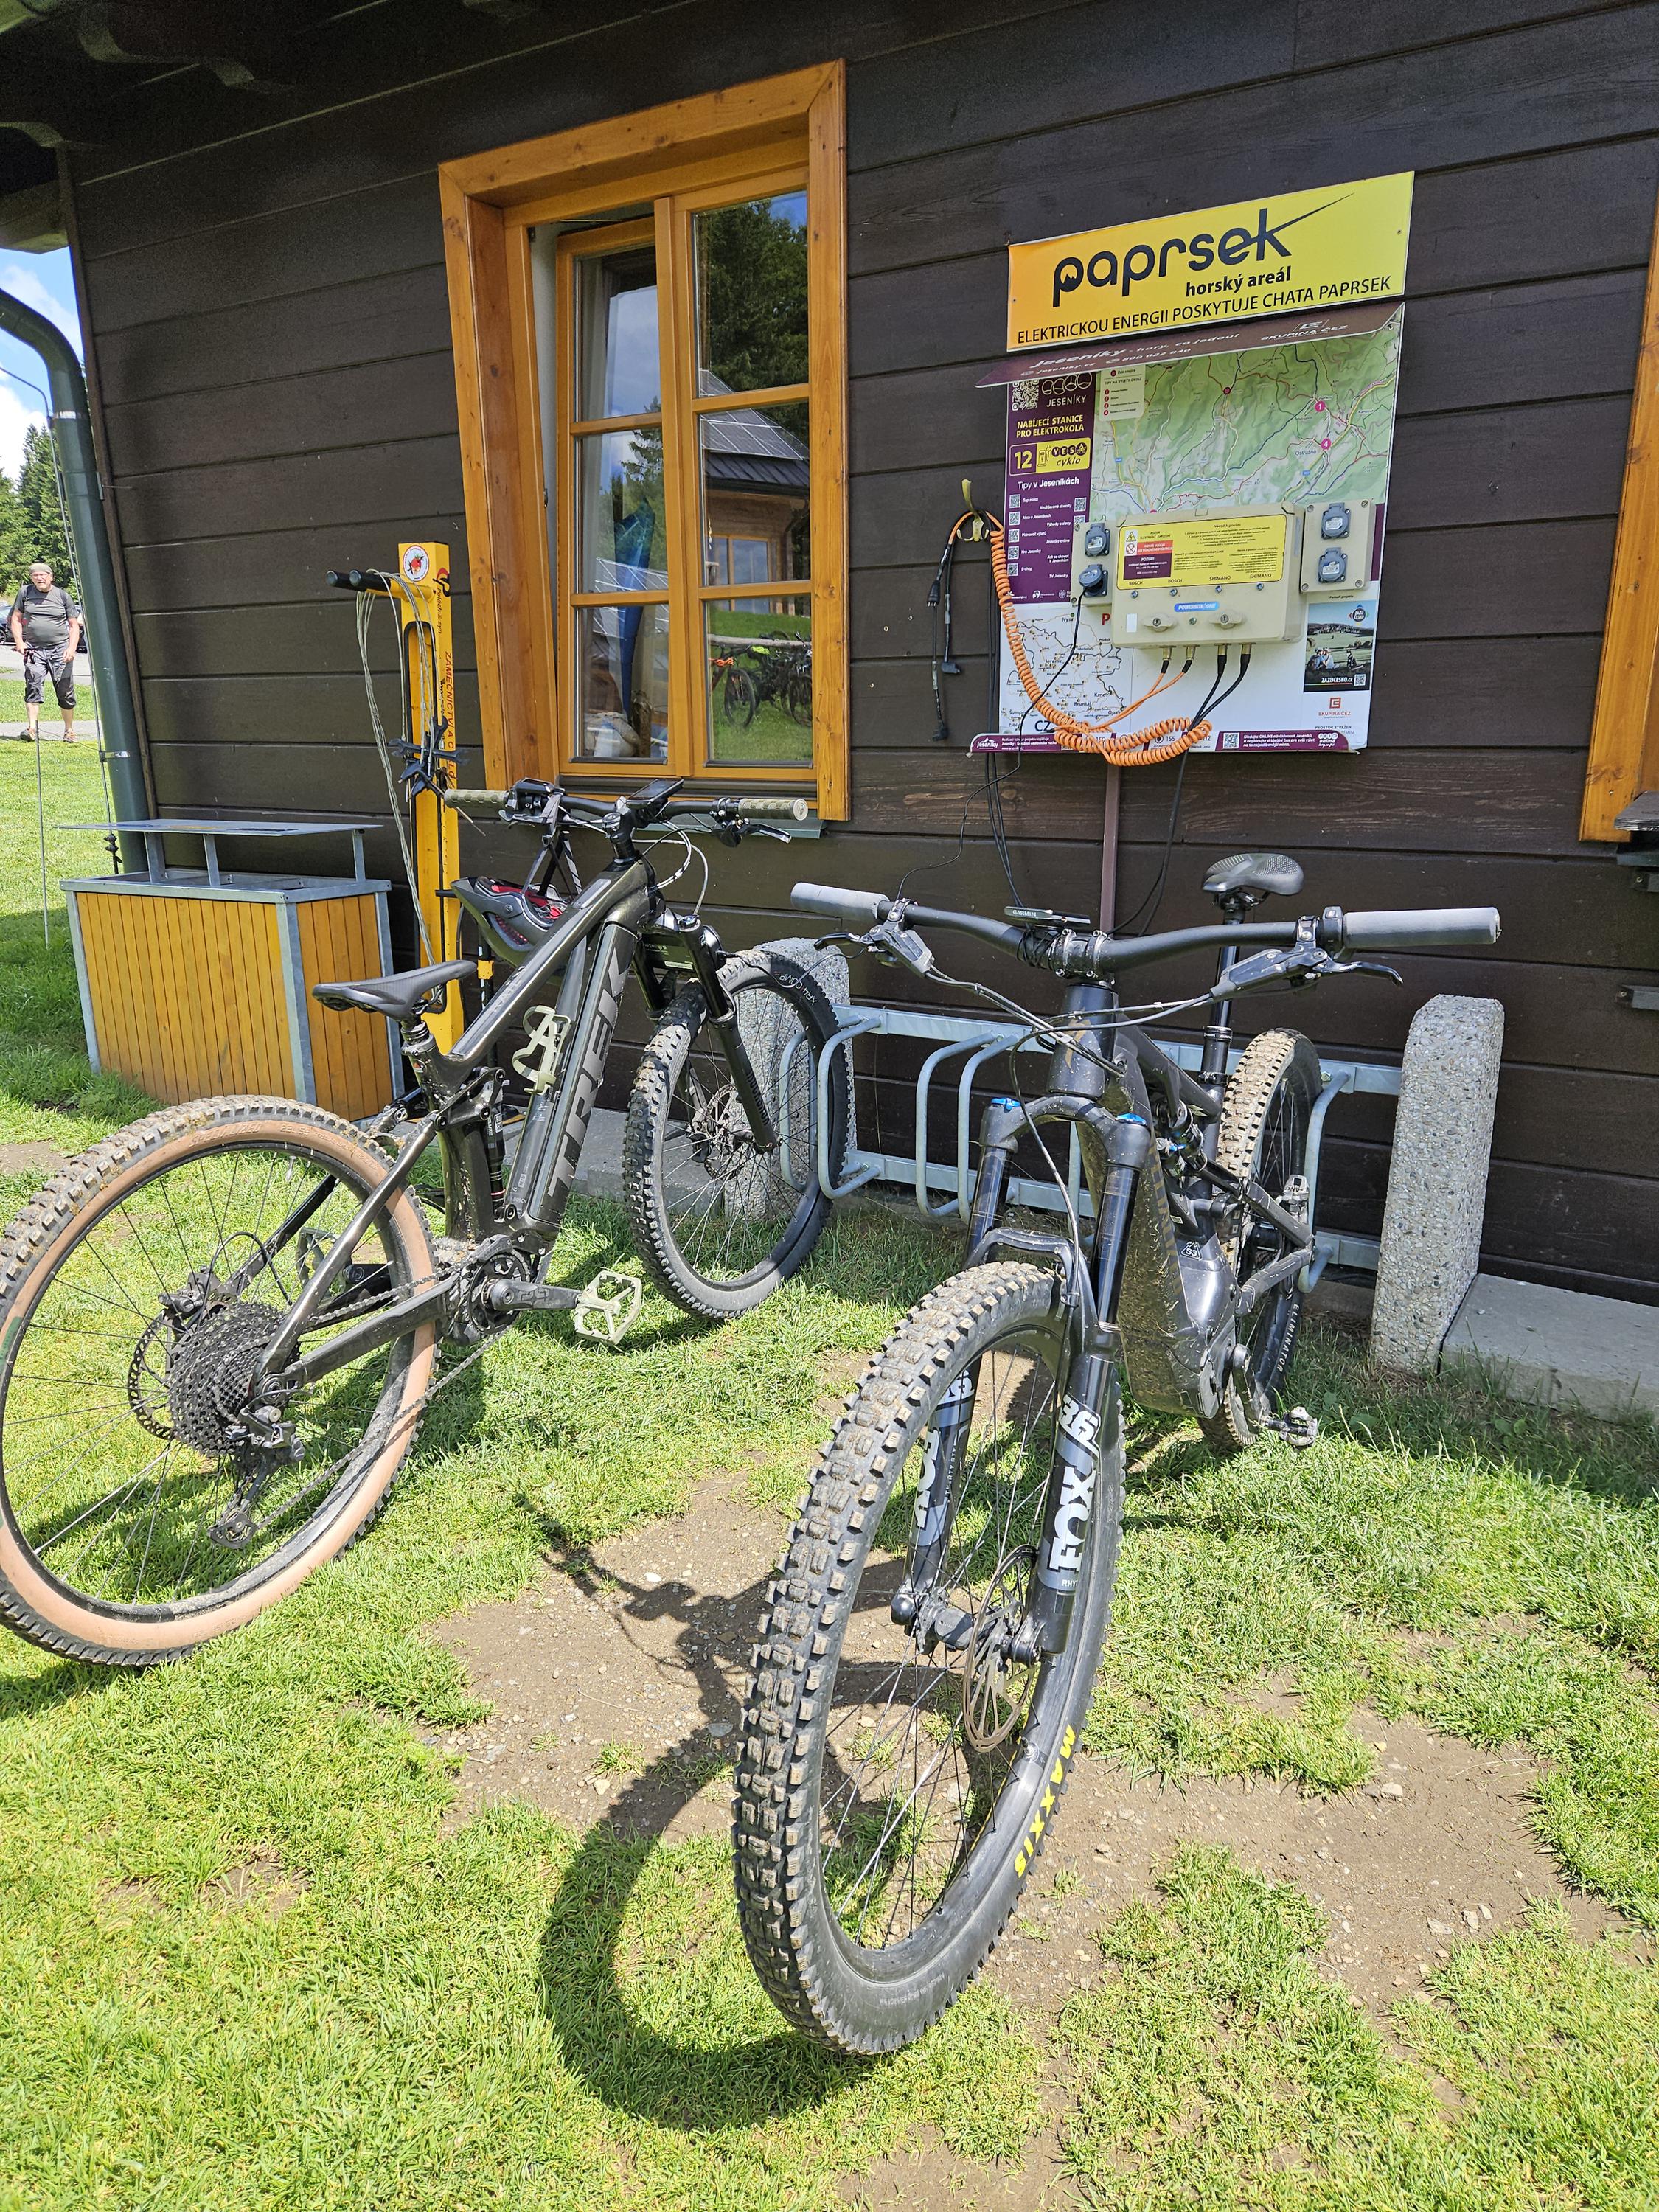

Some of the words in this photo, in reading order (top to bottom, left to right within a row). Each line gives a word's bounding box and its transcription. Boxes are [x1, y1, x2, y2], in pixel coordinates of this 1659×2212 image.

[1052, 206, 1292, 307] paprsek
[1186, 274, 1243, 297] horský
[1248, 266, 1291, 288] areál
[1018, 319, 1108, 343] ELEKTRICKOU
[1113, 310, 1168, 330] ENERGII
[1173, 296, 1258, 321] POSKYTUJE
[1263, 288, 1314, 307] CHATA
[1319, 276, 1391, 299] PAPRSEK
[1046, 394, 1086, 407] JESENÍKY
[1016, 430, 1031, 438] PRO
[1033, 424, 1084, 436] ELEKTROKOLA
[1017, 417, 1049, 428] NABÍJECÍ
[1052, 414, 1083, 425] STANICE
[1015, 451, 1032, 469] 12
[1052, 445, 1076, 456] YES
[1057, 456, 1080, 467] cyklo
[1018, 481, 1032, 490] Tipy
[802, 985, 818, 1005] XR4
[548, 947, 629, 1197] TREK
[1186, 1248, 1197, 1256] S3
[1276, 1303, 1299, 1372] ELIMINATOR
[1059, 1394, 1101, 1445] 36
[1048, 1465, 1097, 1573] FOX
[1015, 1723, 1076, 1878] MAXXIS
